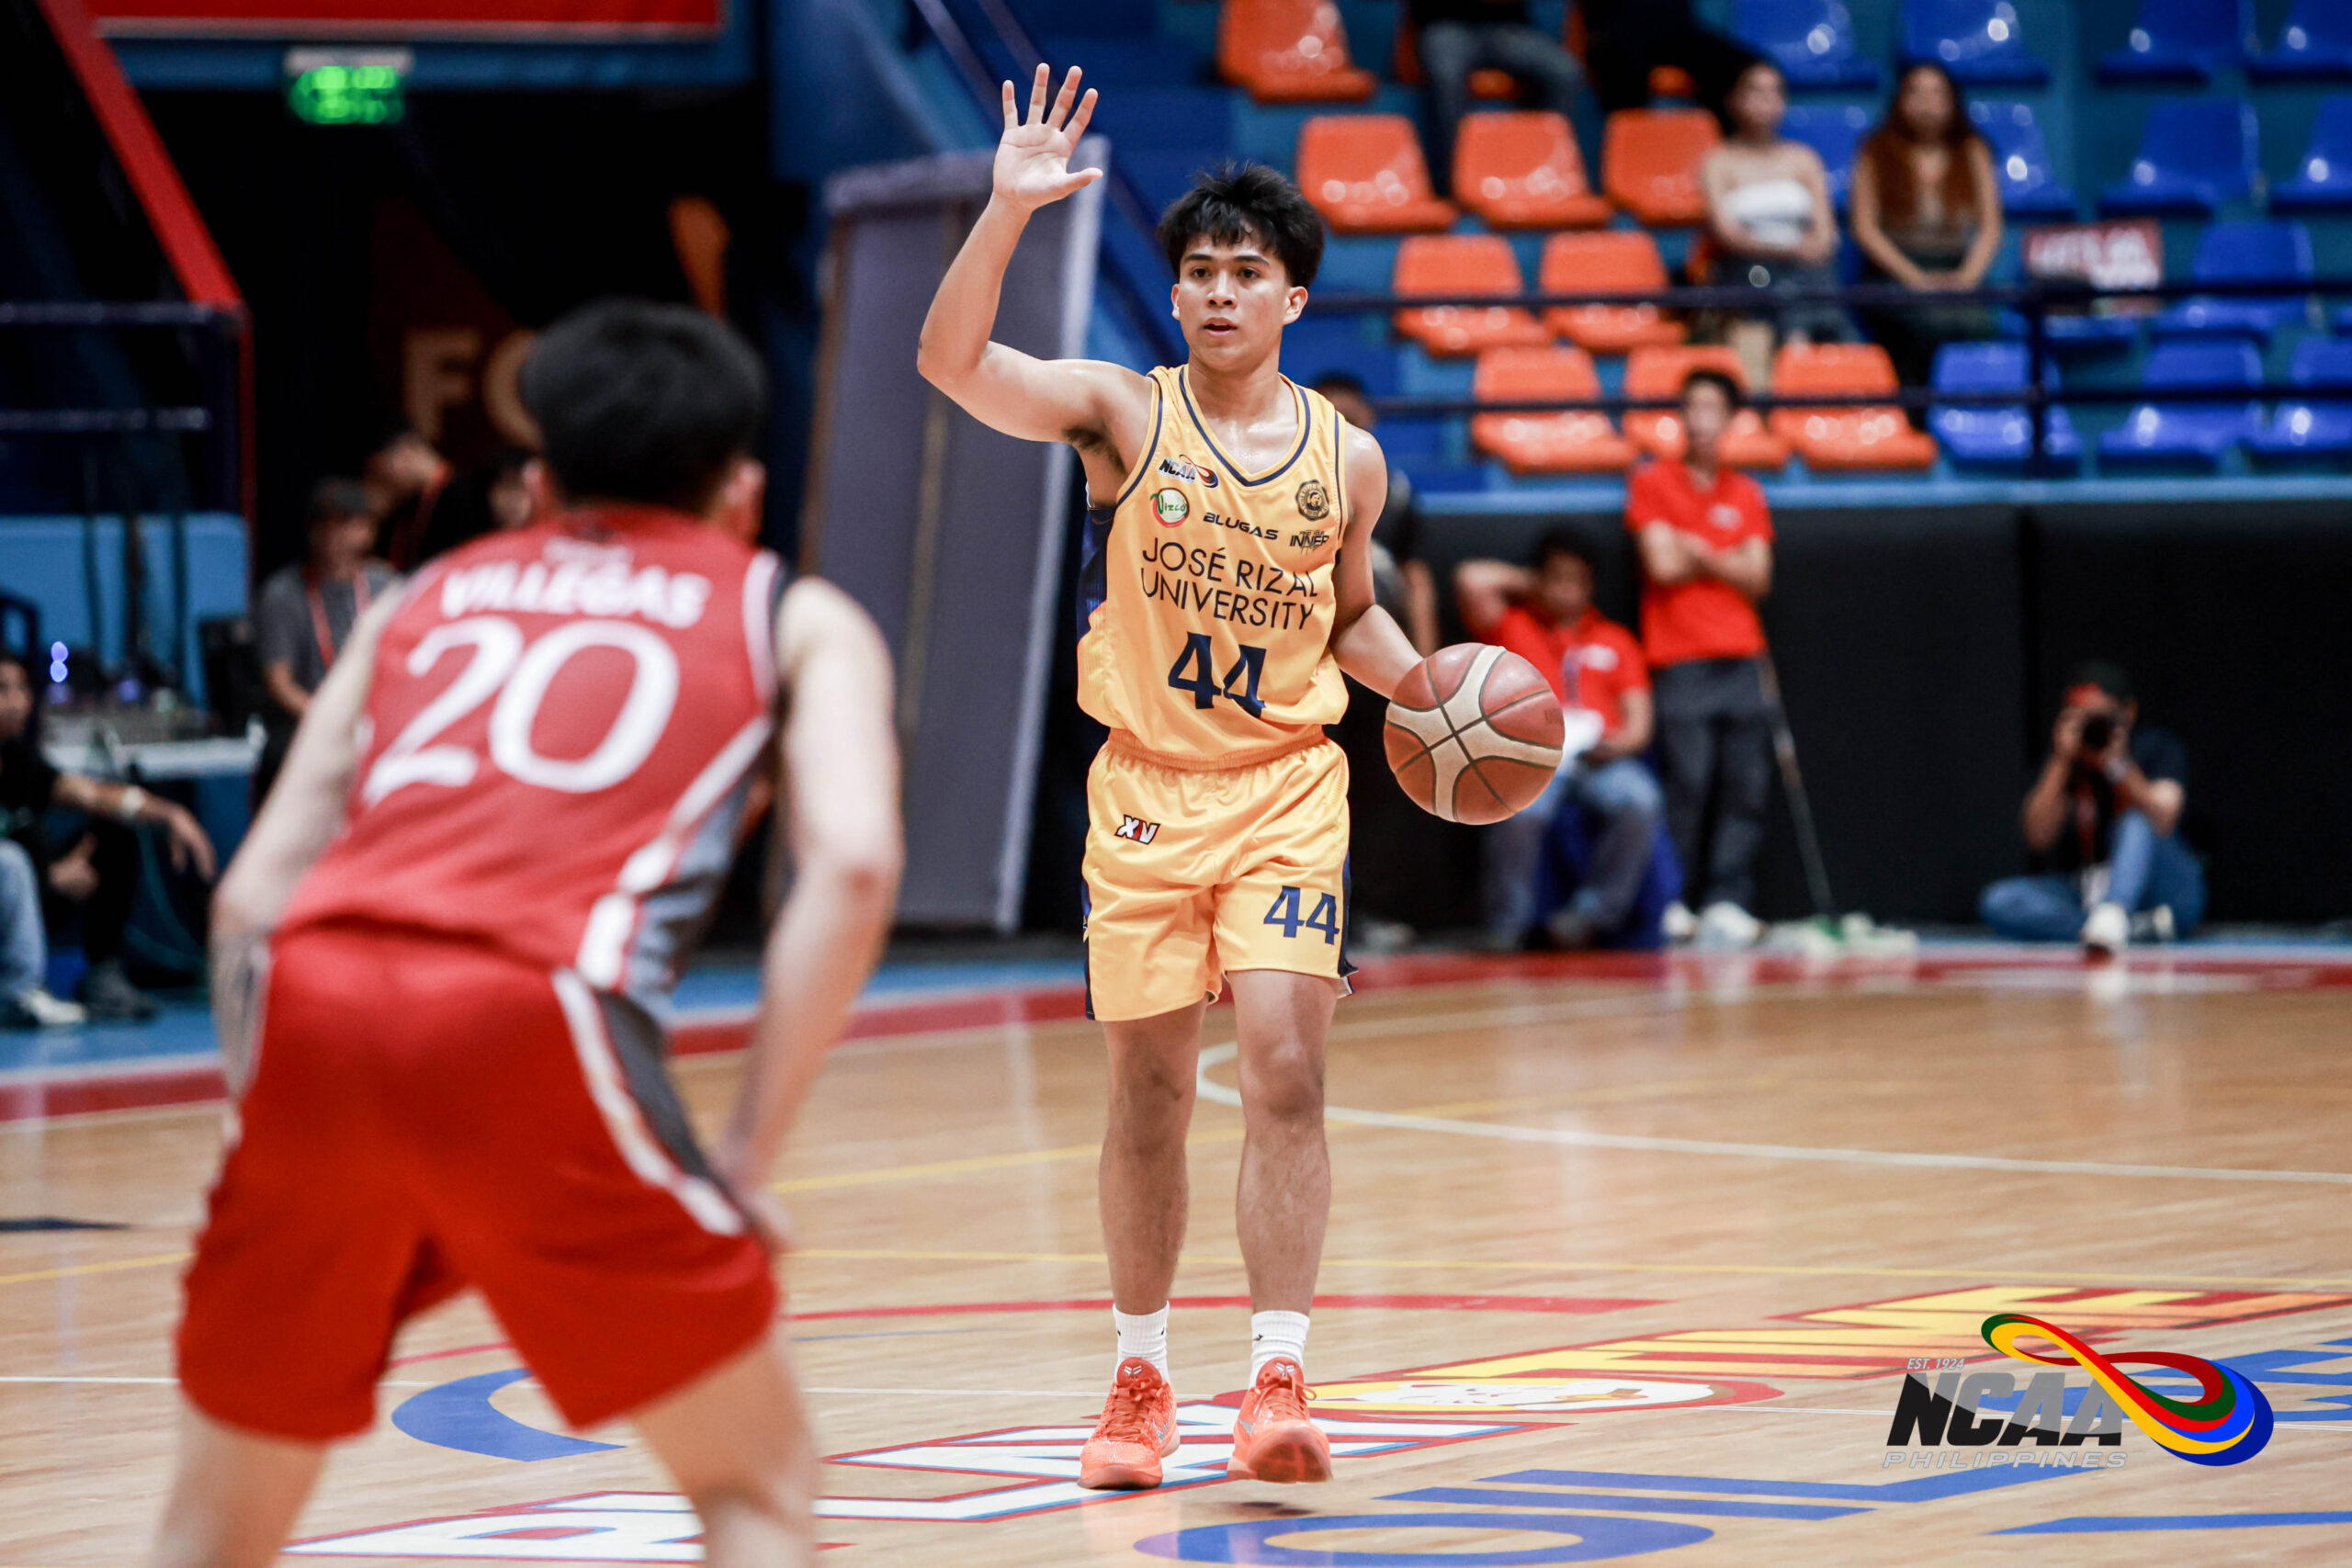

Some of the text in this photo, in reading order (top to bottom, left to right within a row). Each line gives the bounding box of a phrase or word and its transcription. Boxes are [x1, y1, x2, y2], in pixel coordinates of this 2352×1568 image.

[1159, 459, 1196, 480] NCAA
[1203, 512, 1280, 540] BLUGAS
[1289, 535, 1330, 547] INNER
[440, 560, 713, 629] VILLEGAS
[1142, 537, 1319, 598] JOSÉ RIZAL
[1140, 567, 1317, 631] UNIVERSITY
[1167, 631, 1267, 718] 44
[362, 614, 680, 807] 20
[1114, 814, 1161, 845] XV
[1263, 885, 1340, 945] 44
